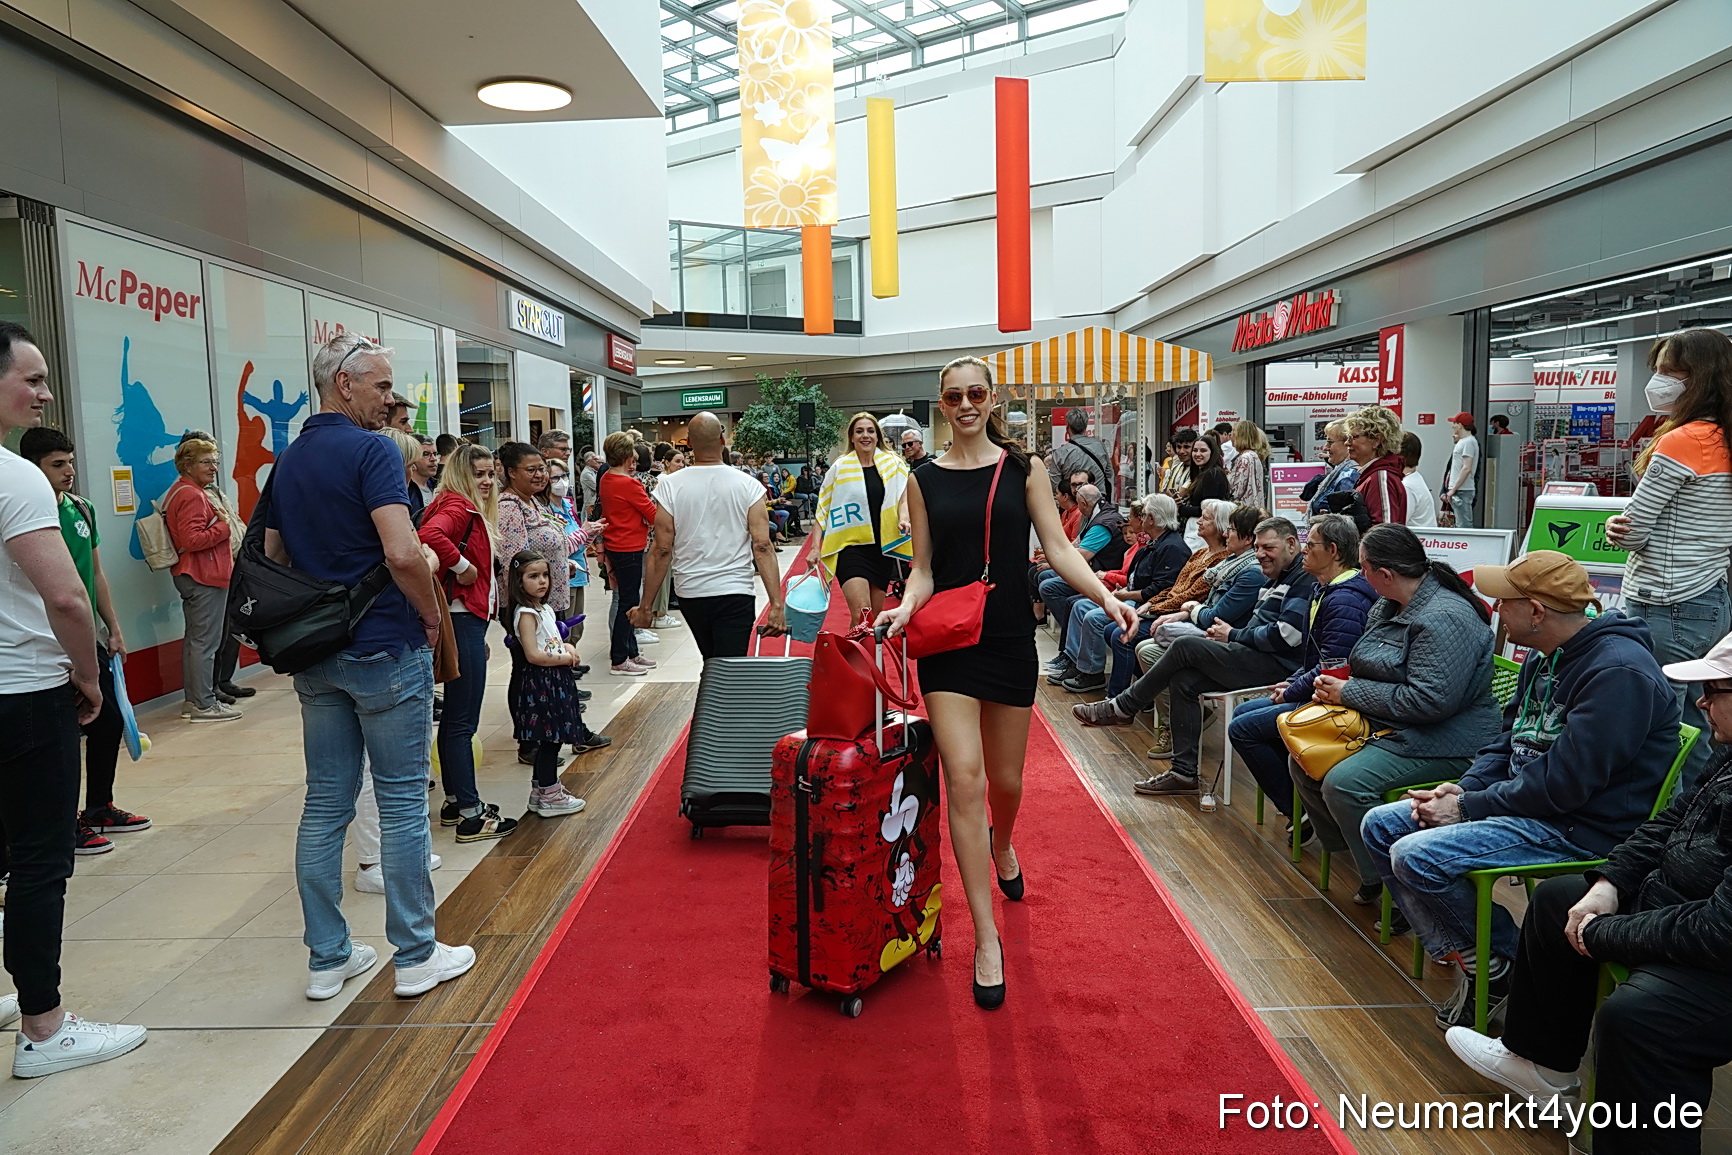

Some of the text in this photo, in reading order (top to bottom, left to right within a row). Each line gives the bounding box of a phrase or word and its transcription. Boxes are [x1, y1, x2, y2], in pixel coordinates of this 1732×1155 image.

[76, 261, 200, 322] McPaper
[517, 299, 562, 341] STARCUT
[1386, 334, 1398, 382] 1
[1338, 367, 1379, 383] KASS
[1534, 371, 1577, 385] MUSIK
[685, 394, 721, 403] LEBENSRAUM
[1268, 391, 1348, 401] Online-Abholung
[830, 502, 864, 528] ER
